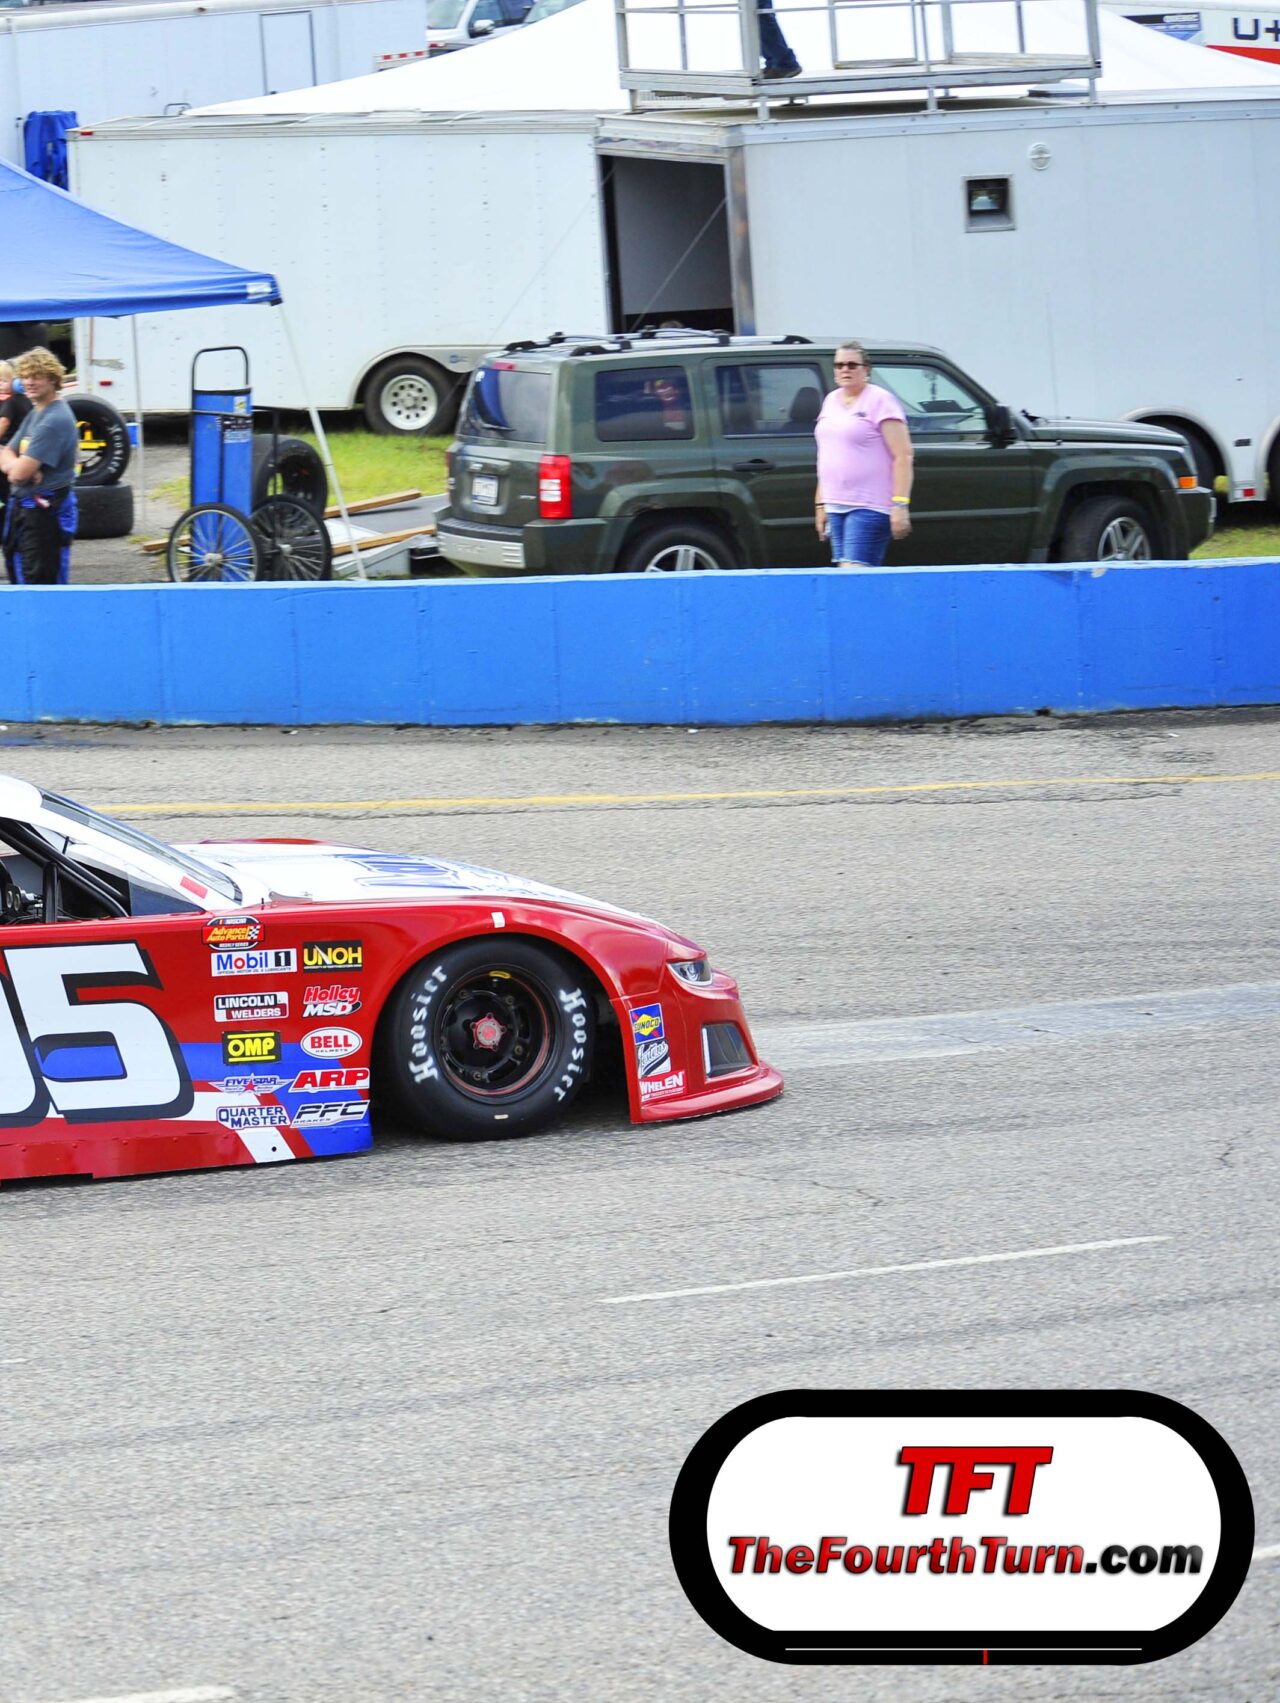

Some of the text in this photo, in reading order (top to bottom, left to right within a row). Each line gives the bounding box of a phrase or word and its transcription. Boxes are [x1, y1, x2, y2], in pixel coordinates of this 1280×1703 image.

[207, 934, 225, 942] Auto
[212, 926, 247, 935] Advance
[217, 952, 268, 971] Mobil
[303, 945, 362, 966] UNOH
[218, 995, 274, 1009] LINCOLN
[303, 985, 360, 1004] Holley
[231, 1007, 282, 1019] WELDERS
[303, 1001, 353, 1017] MSD
[407, 964, 449, 1084] Hoosier
[633, 1017, 661, 1032] SUNOCO
[227, 1037, 275, 1057] OMP
[310, 1035, 352, 1049] BELL
[553, 986, 589, 1102] Hoosier
[225, 1077, 277, 1087] FIVE STAR
[293, 1070, 369, 1089] ARP
[640, 1071, 684, 1096] WHELEN
[218, 1106, 283, 1122] QUARTER
[296, 1101, 369, 1120] PFC
[231, 1115, 288, 1129] MASTER
